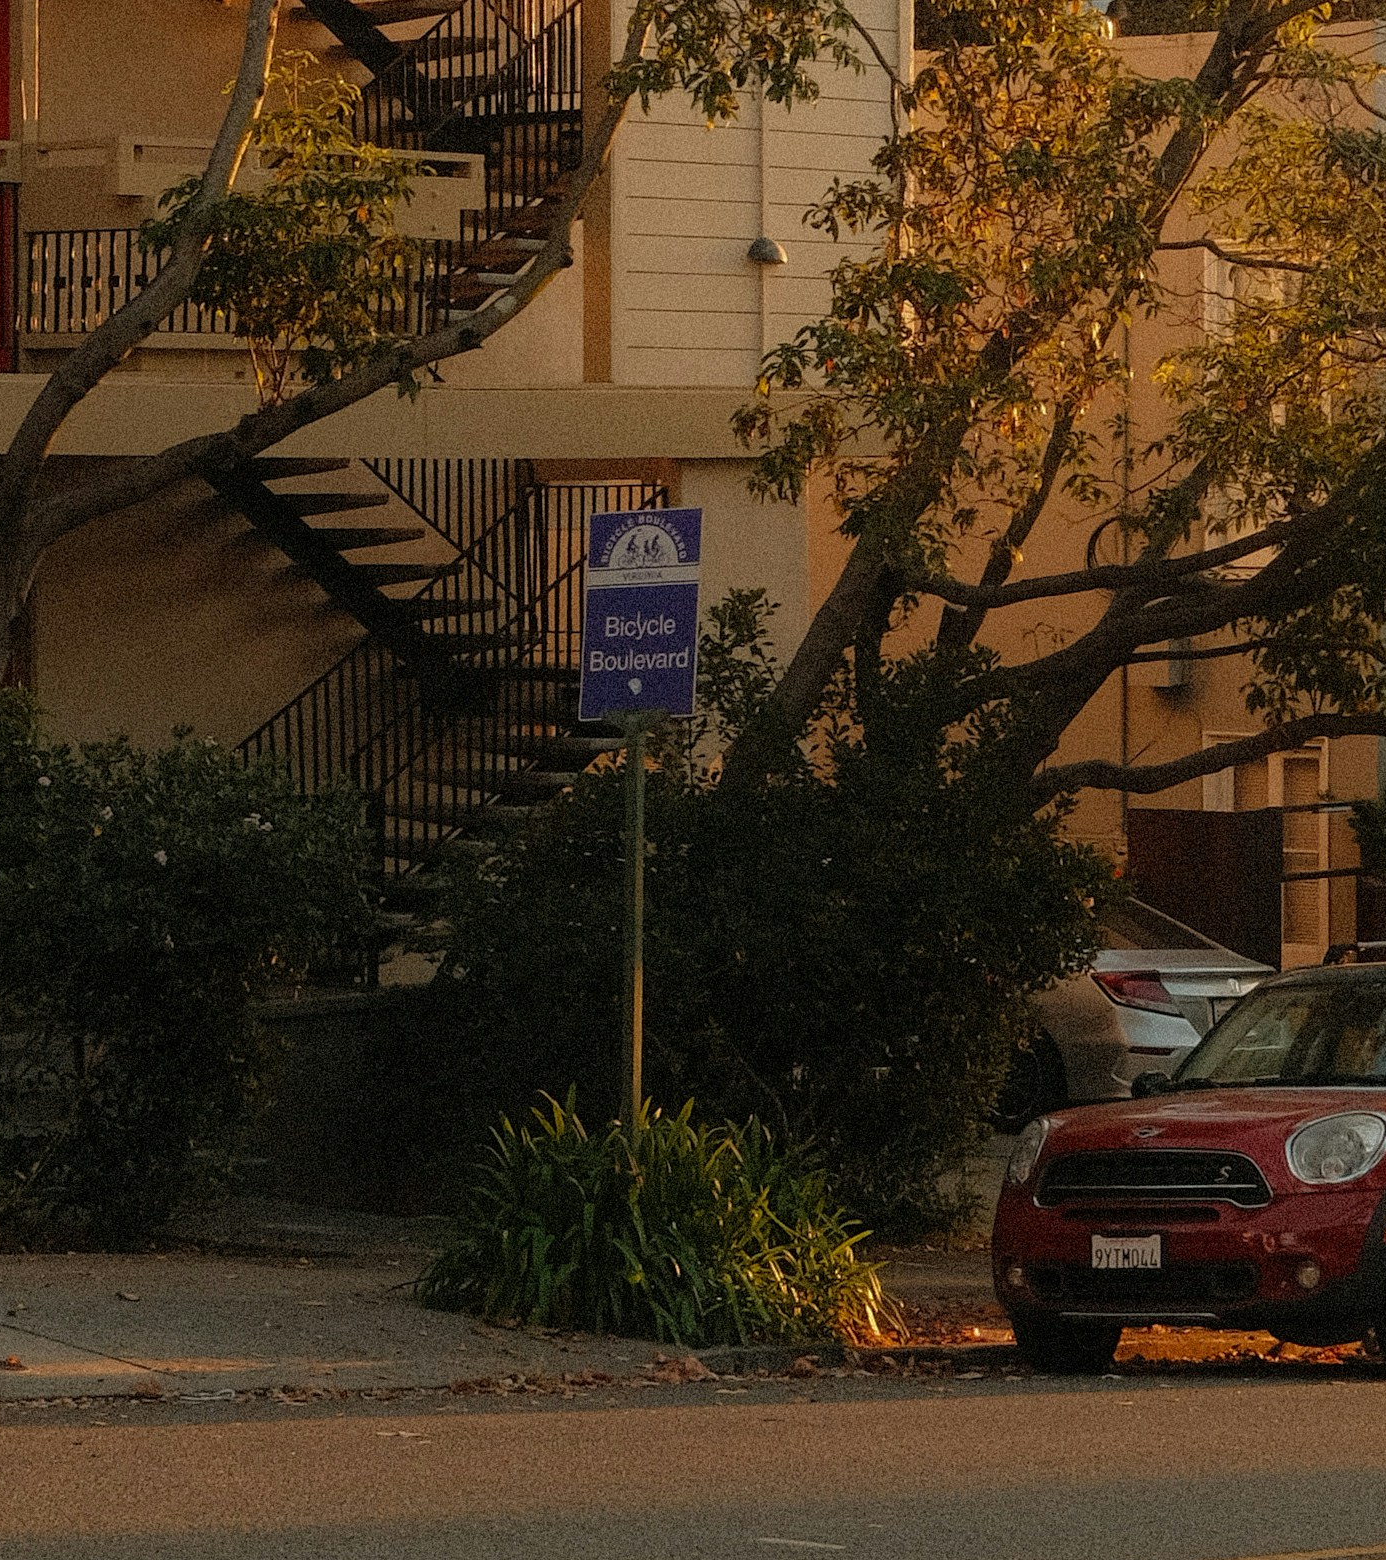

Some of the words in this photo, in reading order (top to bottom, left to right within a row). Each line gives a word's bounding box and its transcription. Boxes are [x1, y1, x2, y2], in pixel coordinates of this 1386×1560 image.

[600, 518, 635, 563] BICYCLE
[637, 515, 687, 560] BOULEVARD
[605, 611, 676, 640] Bicycle
[590, 646, 689, 672] Boulevard
[1095, 1247, 1158, 1269] 9YTM044
